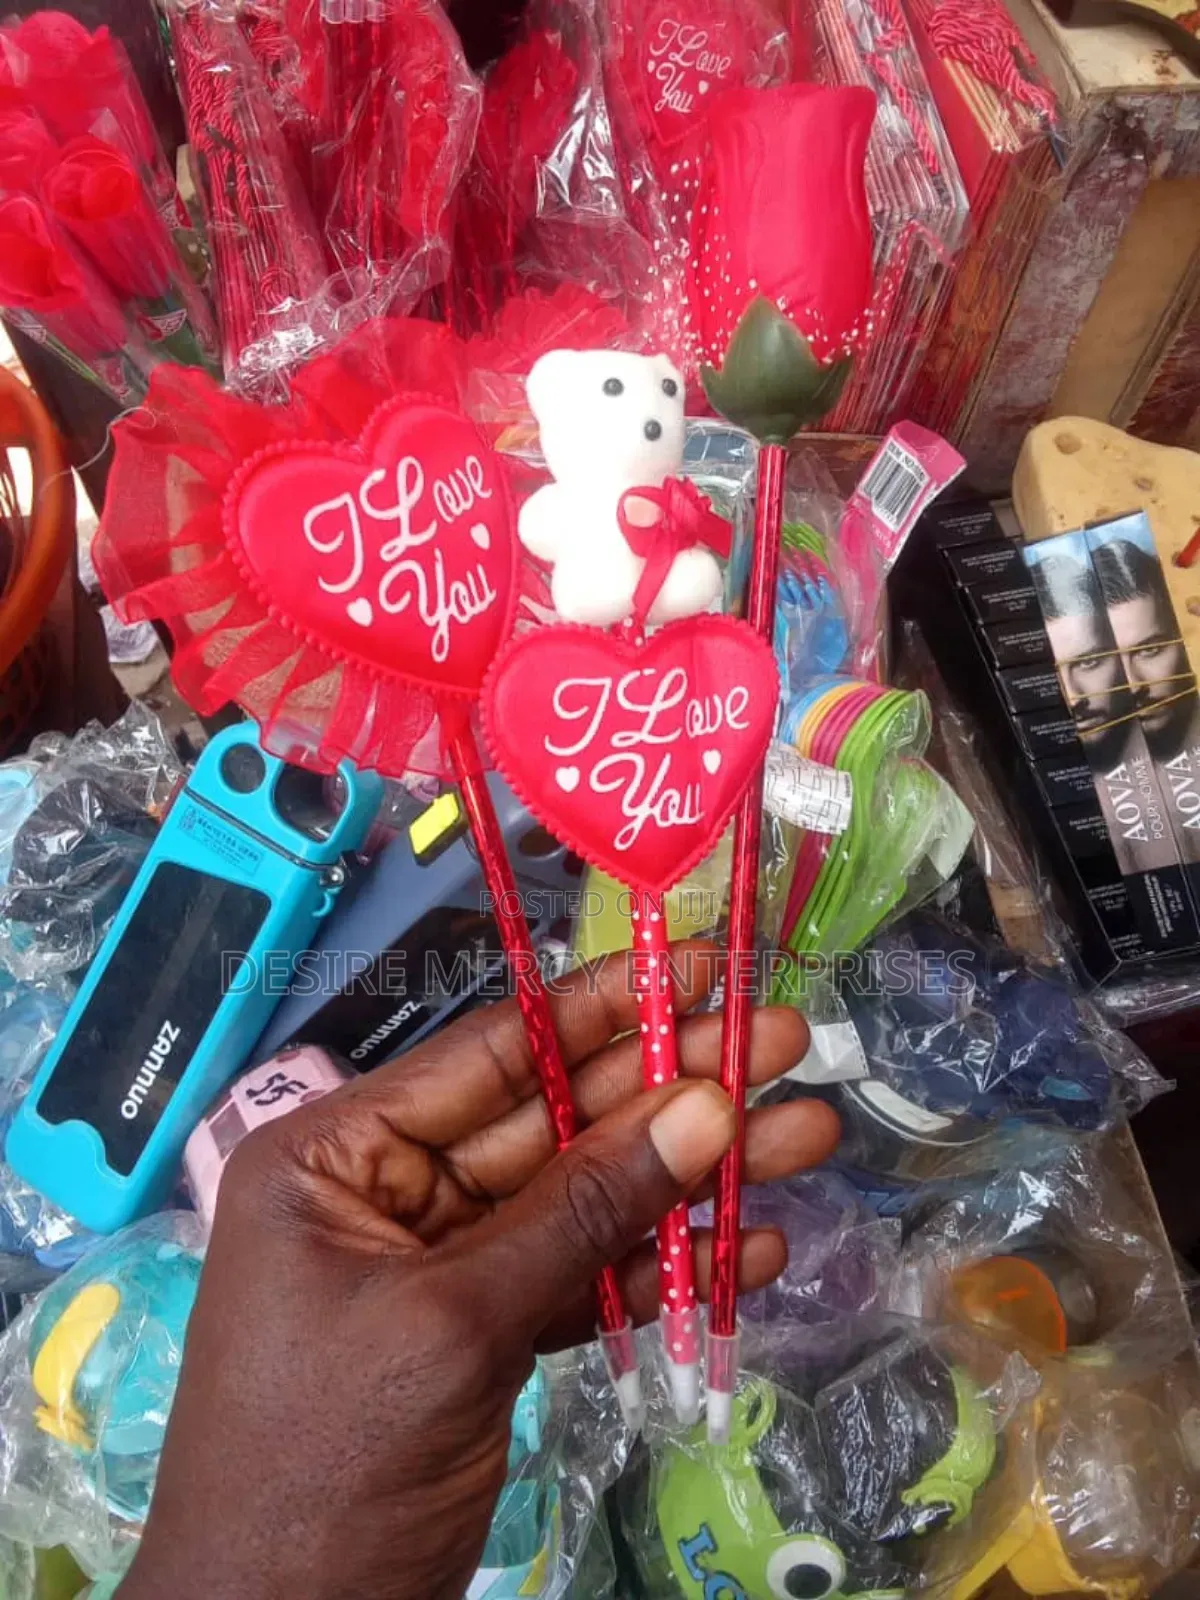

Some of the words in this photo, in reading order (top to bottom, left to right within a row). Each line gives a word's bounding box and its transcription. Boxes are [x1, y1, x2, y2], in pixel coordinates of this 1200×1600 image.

[654, 61, 694, 113] You
[668, 25, 731, 79] Love
[359, 455, 492, 562] Love
[378, 547, 496, 664] You
[611, 667, 750, 748] Love
[589, 752, 705, 851] You
[1104, 762, 1149, 842] AOVA
